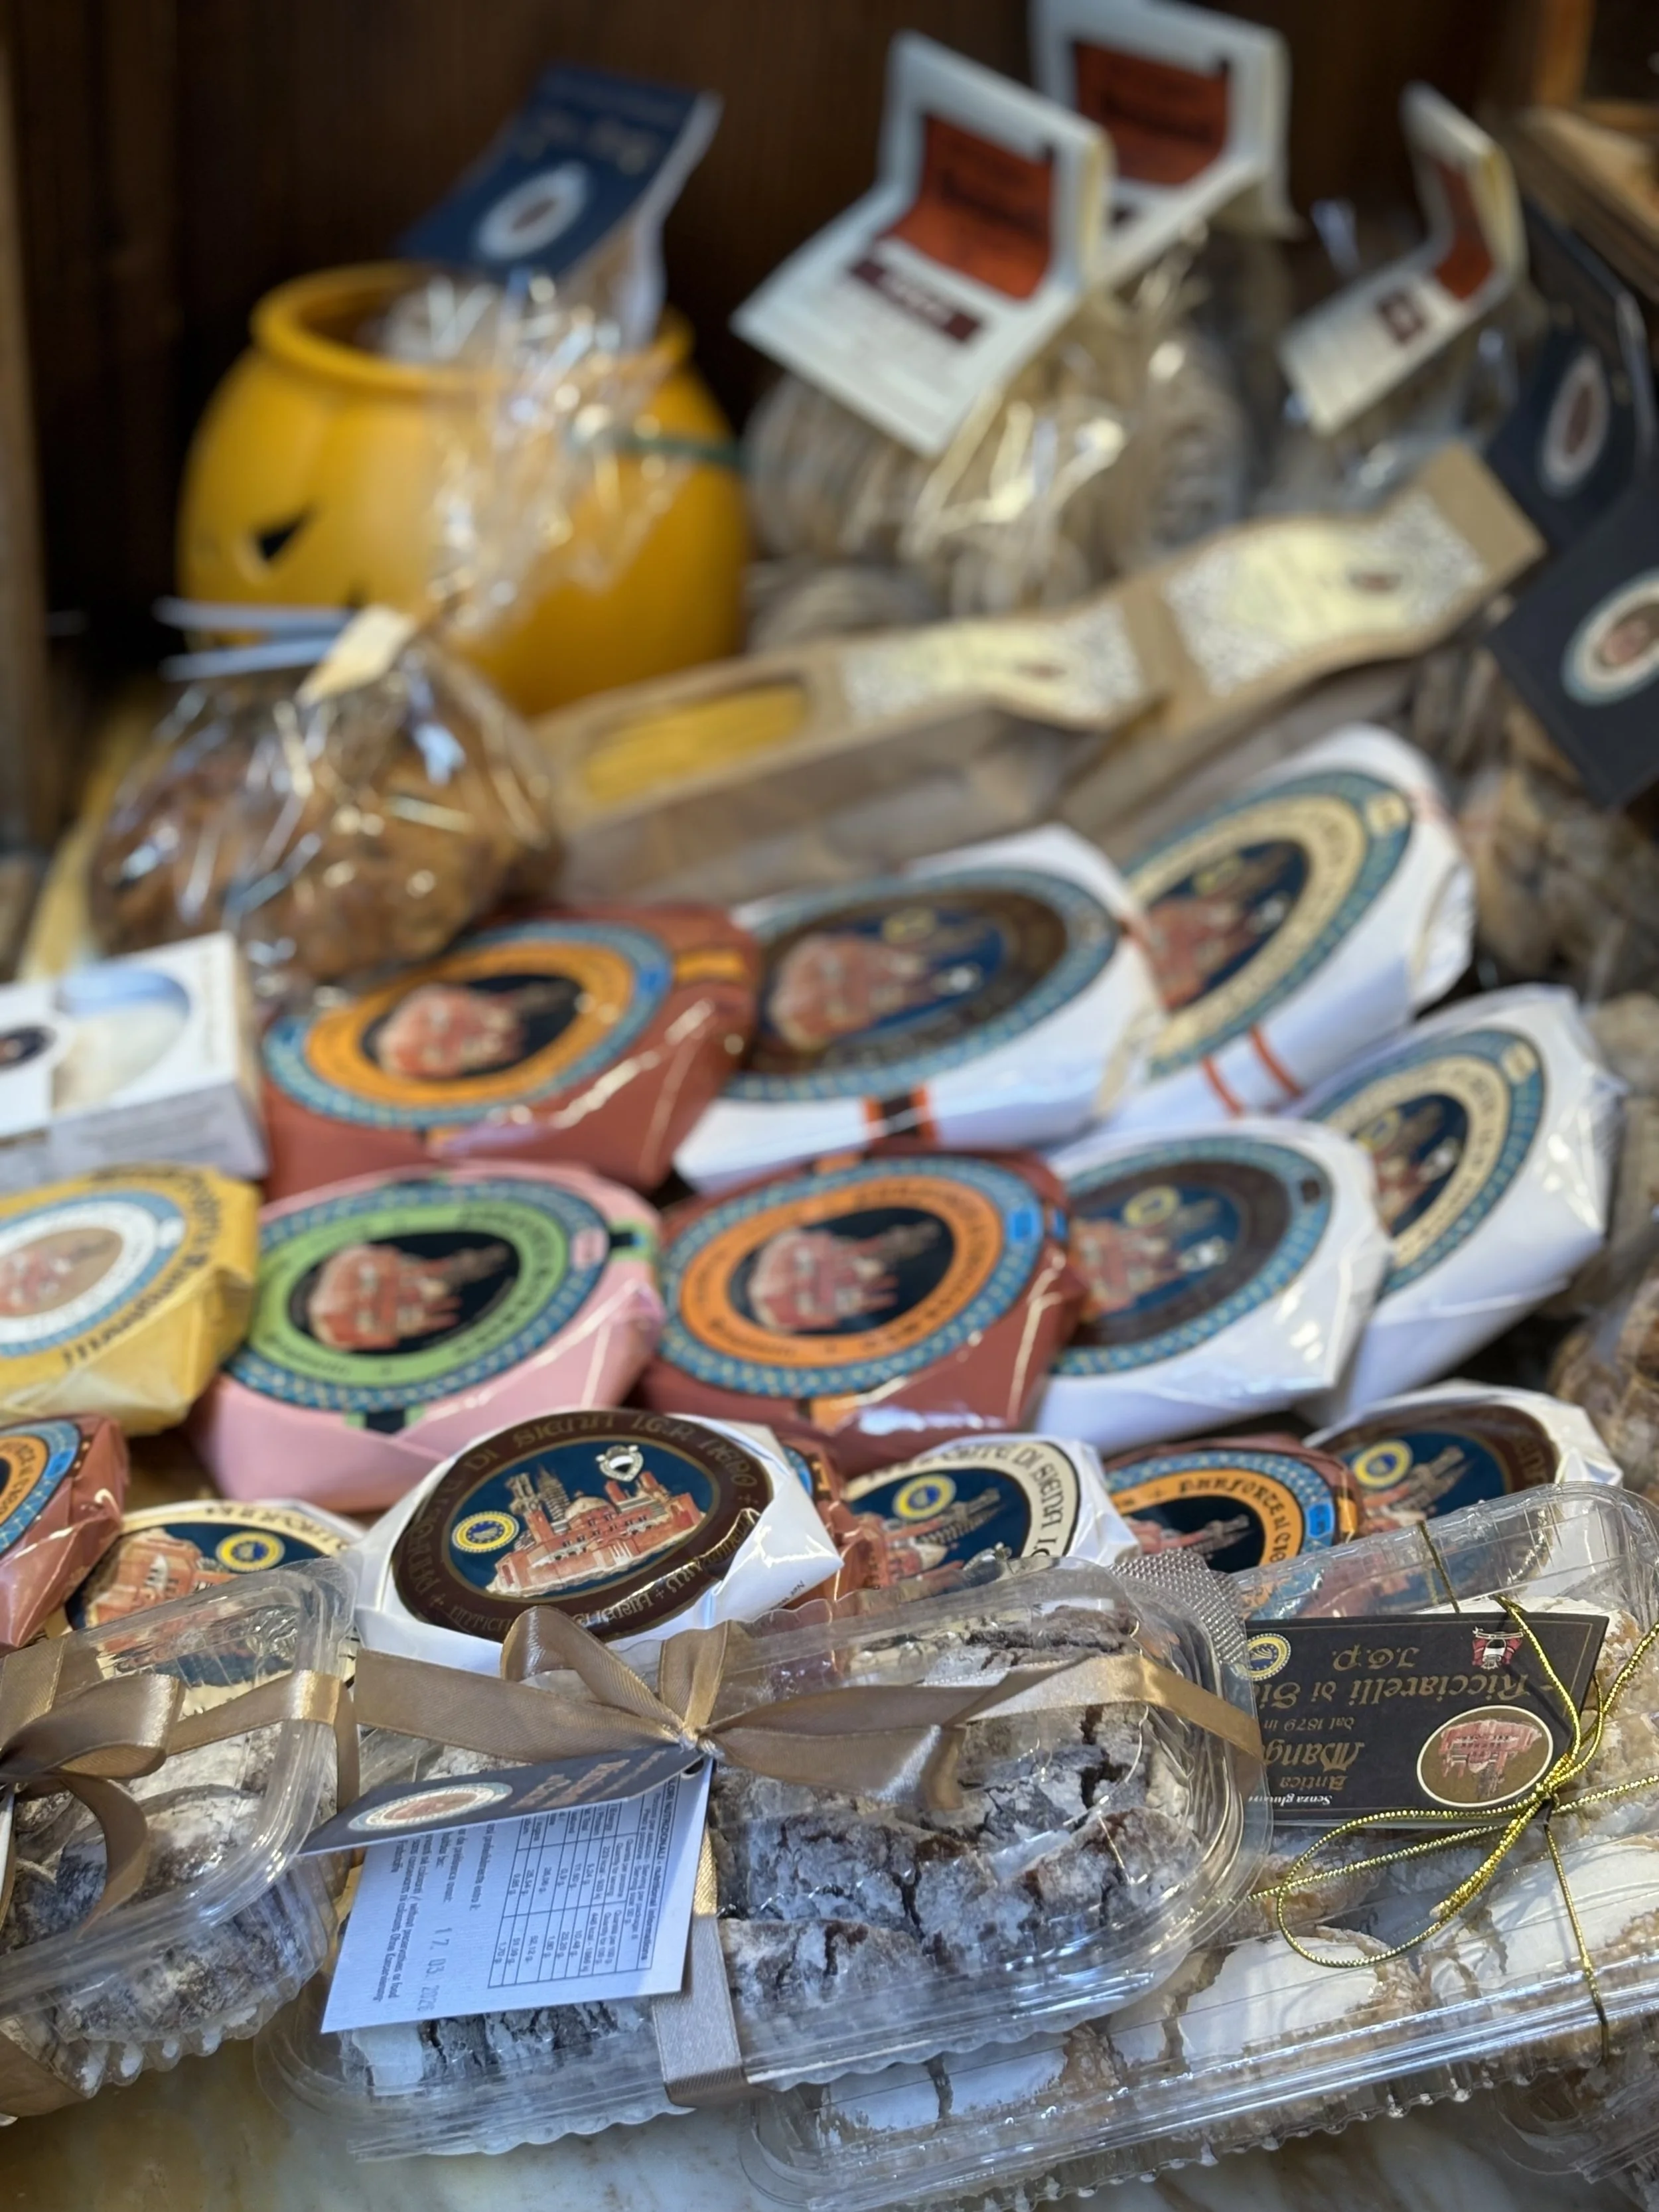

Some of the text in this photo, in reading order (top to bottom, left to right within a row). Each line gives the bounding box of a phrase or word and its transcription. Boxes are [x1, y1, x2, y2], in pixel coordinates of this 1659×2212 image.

[465, 1447, 500, 1471] DI
[512, 1414, 616, 1449] SIENA
[1310, 1680, 1336, 1702] di
[1348, 1673, 1531, 1706] Ricciarelli
[1263, 1716, 1354, 1732] dal 1879 in
[1261, 1739, 1364, 1773] Mang
[1279, 1775, 1348, 1791] Antica
[1297, 1795, 1333, 1805] Senza
[656, 1801, 674, 1860] NUTRIZIONALI
[628, 1864, 642, 1891] Serving
[637, 1864, 650, 1890] Serving
[648, 1864, 663, 1907] nutritional
[387, 1981, 403, 1999] food
